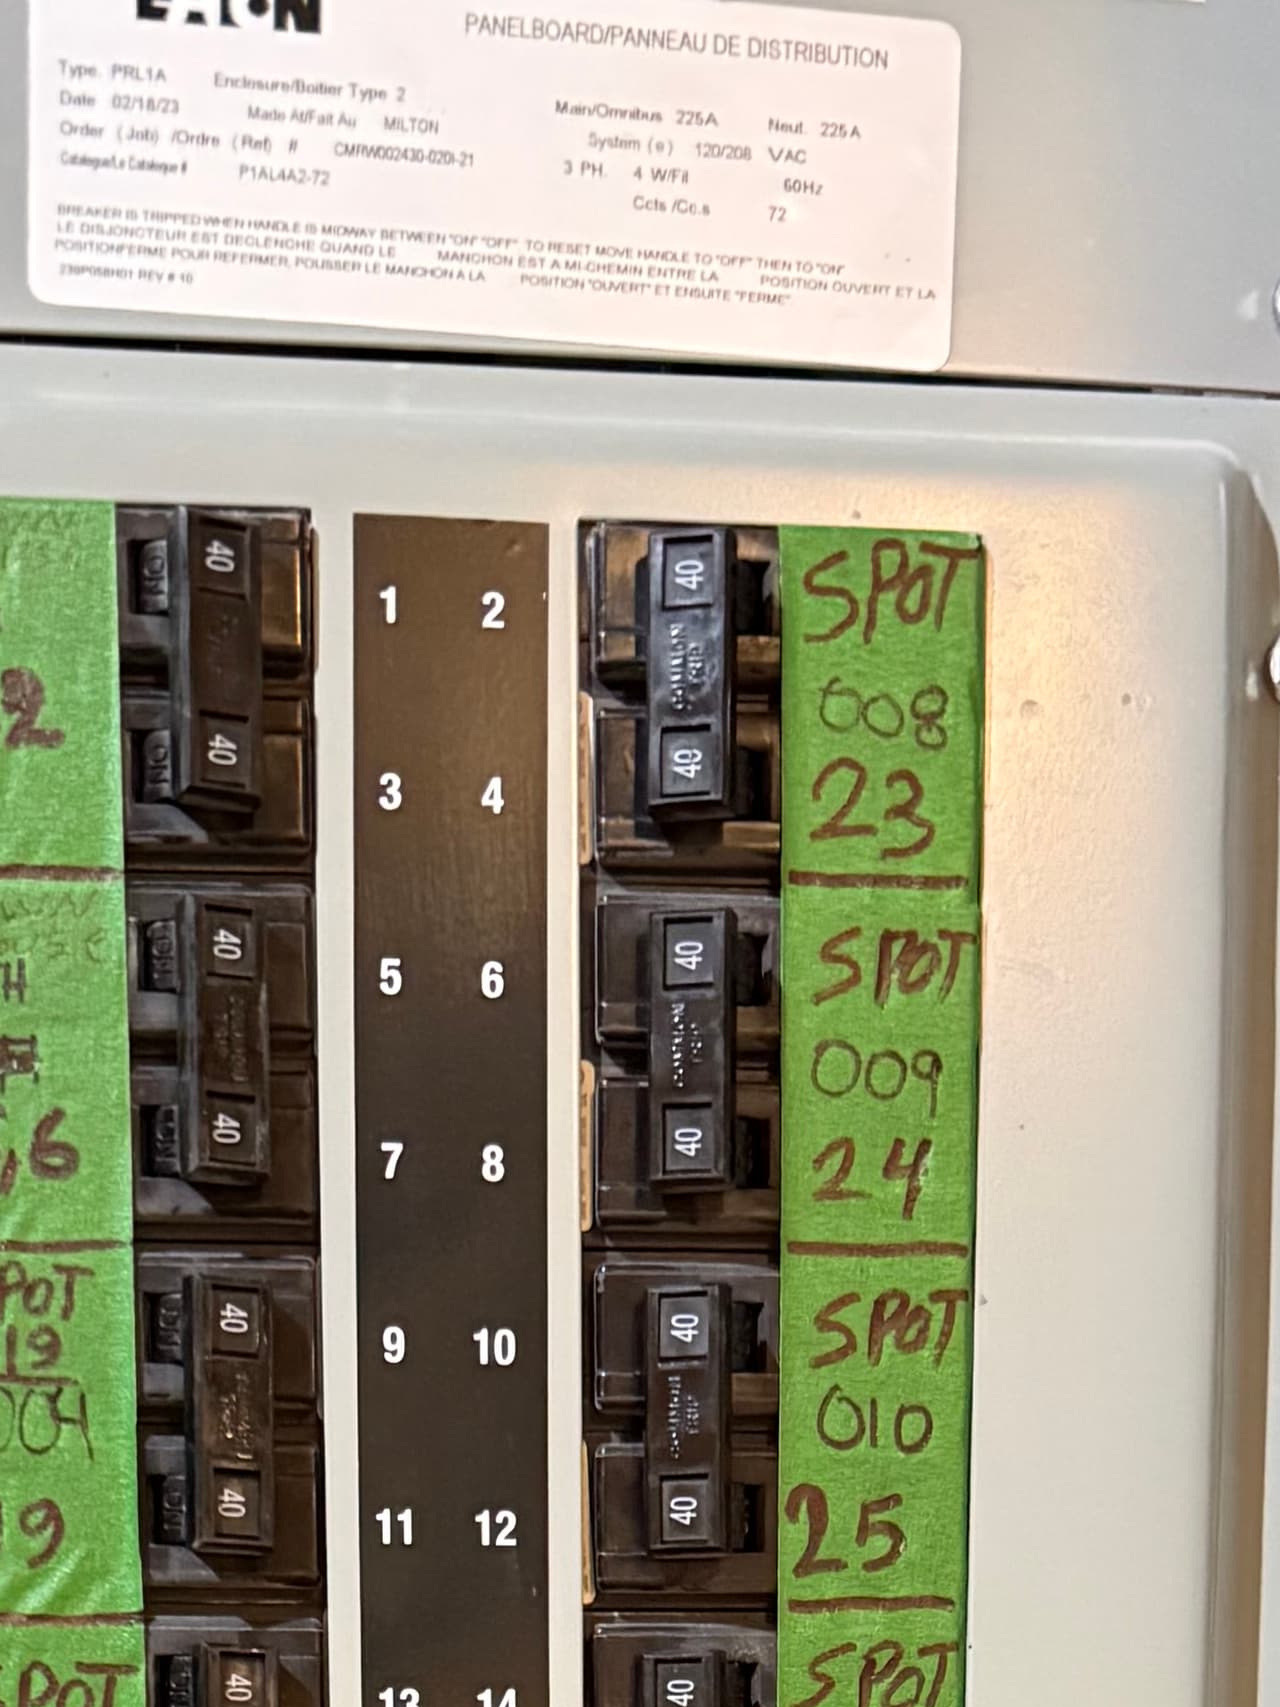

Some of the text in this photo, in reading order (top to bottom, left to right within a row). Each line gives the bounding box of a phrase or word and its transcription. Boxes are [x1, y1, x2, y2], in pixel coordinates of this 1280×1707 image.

[465, 13, 888, 70] PANELBOARD/PANNEAU DE DISTRIBUTION
[60, 91, 96, 107] Date
[349, 82, 387, 102] Type
[396, 88, 406, 102] 2
[60, 122, 104, 139] Order
[247, 105, 286, 123] Made
[384, 116, 439, 135] MILTON
[676, 109, 718, 127] 225A
[768, 147, 807, 165] VAC
[633, 166, 643, 182] 4
[783, 178, 823, 196] 60Hz
[769, 206, 787, 223] 72
[206, 541, 234, 570] 40
[380, 587, 504, 628] 1 2
[803, 538, 980, 644] SPOT
[673, 749, 702, 778] 40
[380, 773, 504, 813] 3 4
[810, 756, 936, 860] 23
[214, 930, 241, 959] 40
[380, 958, 504, 998] 5 6
[814, 926, 978, 1007] SPOT
[810, 1038, 943, 1120] 009
[675, 1128, 702, 1156] 40
[381, 1143, 504, 1181] 7 8
[812, 1136, 933, 1221] 24
[221, 1304, 248, 1332] 40
[809, 1289, 969, 1368] SPOT
[383, 1327, 515, 1365] 9 10
[817, 1384, 933, 1455] 010
[376, 1509, 516, 1545] 11 12
[670, 1497, 697, 1524] 40
[784, 1484, 908, 1580] 25
[227, 1674, 251, 1700] 40
